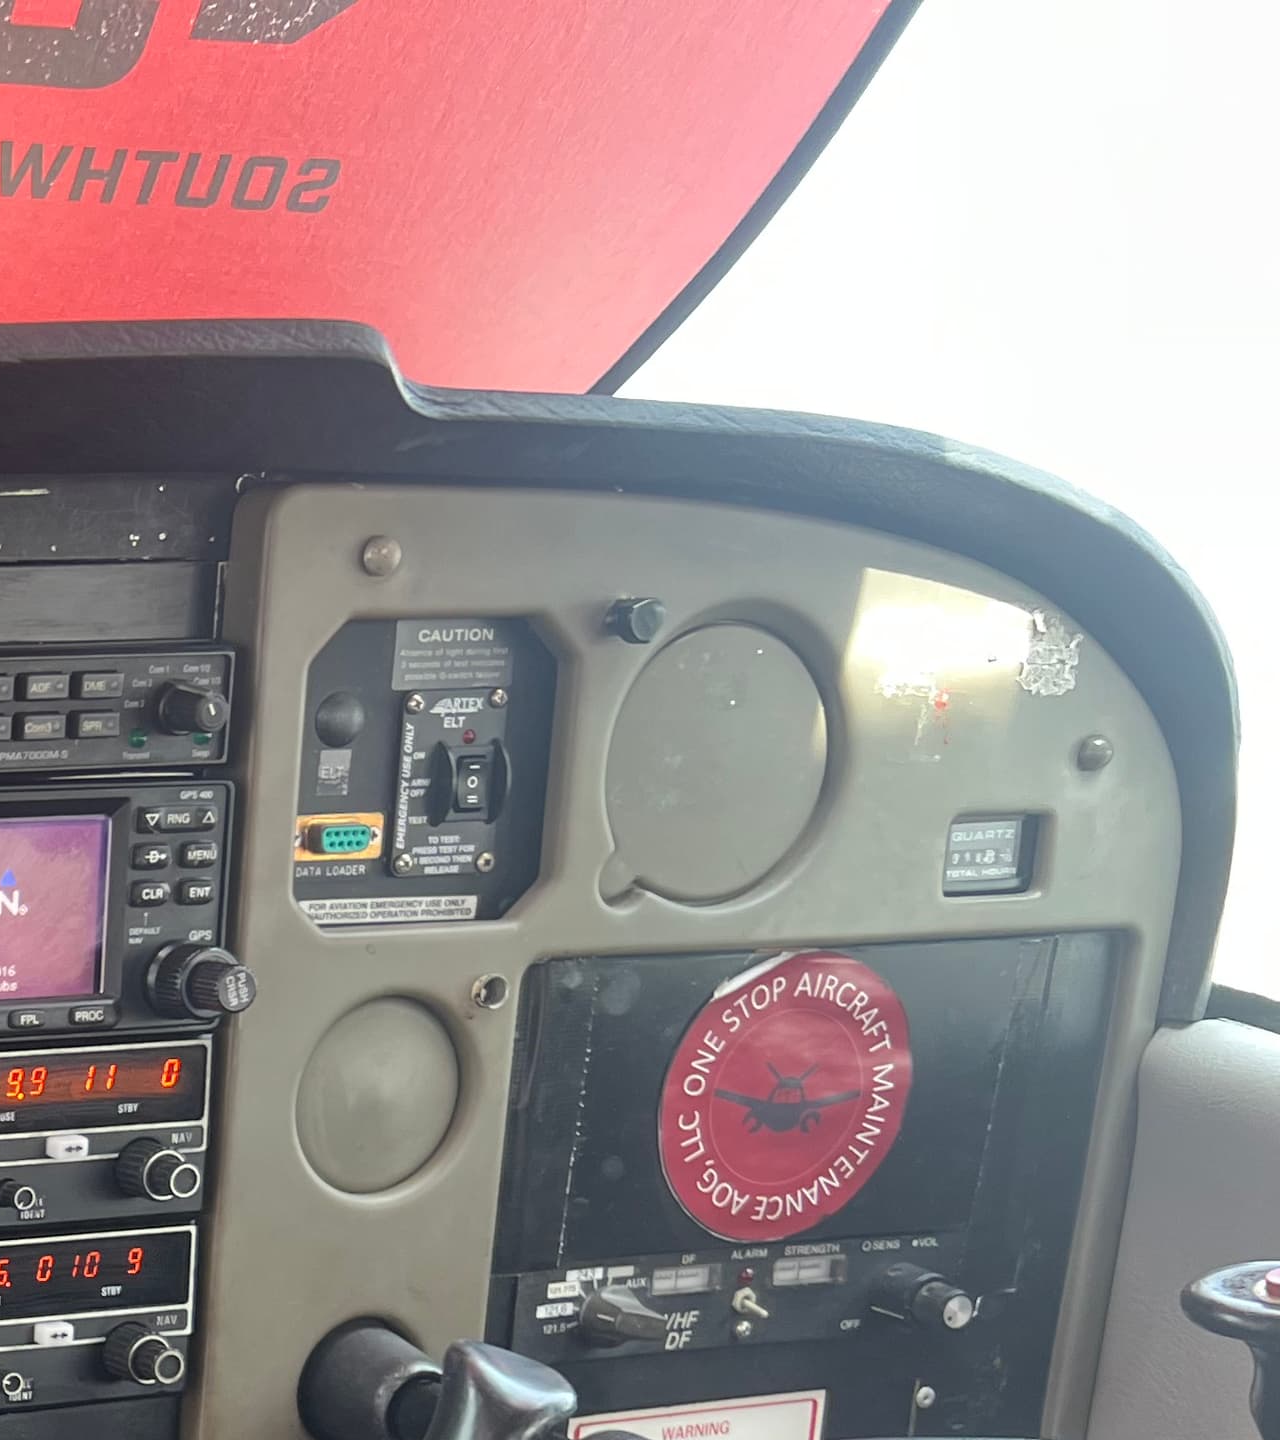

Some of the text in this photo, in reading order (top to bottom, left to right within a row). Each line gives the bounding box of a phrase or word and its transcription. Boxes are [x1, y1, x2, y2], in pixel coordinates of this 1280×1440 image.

[419, 628, 494, 642] CAUTION
[444, 717, 466, 728] ELT
[167, 812, 190, 825] RNG
[952, 829, 1015, 842] QUARTZ
[187, 848, 217, 862] MENU
[295, 864, 366, 877] DATA LOADER
[142, 887, 163, 900] CLR
[189, 886, 211, 899] ENT
[722, 975, 787, 1032] STOP
[74, 1008, 104, 1023] PROC
[794, 972, 892, 1051] AIRCRAFT
[20, 1013, 40, 1027] FPL
[683, 1031, 726, 1098] ONE
[678, 1111, 708, 1163] LLC
[751, 1064, 895, 1221] MAINTENANCE
[731, 1248, 768, 1260] ALARM
[784, 1243, 840, 1255] STRENGTH
[665, 1331, 692, 1350] DF
[662, 1420, 730, 1440] WARNING
